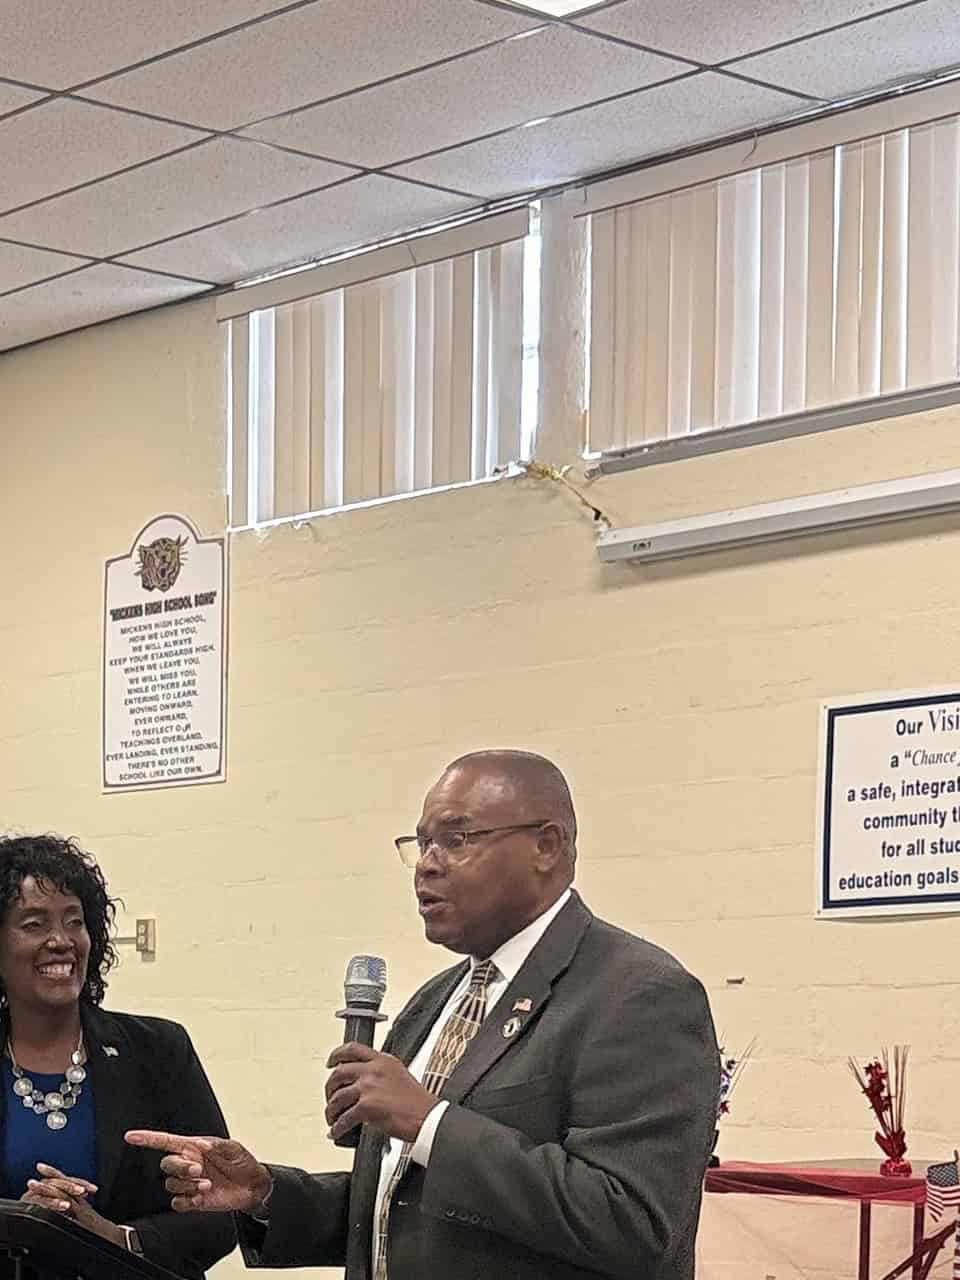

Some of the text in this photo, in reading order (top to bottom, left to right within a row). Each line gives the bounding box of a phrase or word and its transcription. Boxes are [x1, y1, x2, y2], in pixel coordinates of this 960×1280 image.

[164, 595, 192, 612] SCHOOL
[160, 629, 178, 638] LOVE
[164, 638, 192, 648] ALWAYS
[110, 658, 127, 666] KEEP
[129, 655, 148, 663] YOUR
[151, 647, 193, 660] STANDARDS
[160, 660, 181, 669] LEAVE
[142, 675, 157, 683] WILL
[151, 682, 179, 692] OTHERS
[124, 695, 159, 705] ENTERING
[130, 705, 157, 715] MOVING
[135, 717, 152, 726] EVER
[143, 726, 173, 735] REFLECT
[896, 719, 923, 736] Our
[160, 747, 178, 755] EVER
[171, 757, 194, 765] OTHER
[891, 755, 899, 768] a
[120, 772, 147, 781] SCHOOL
[167, 768, 183, 776] OUR
[848, 789, 855, 802] a
[861, 783, 896, 802] safe,
[864, 808, 946, 829] community
[882, 841, 901, 857] for
[906, 839, 925, 856] all
[839, 867, 959, 890] education goals
